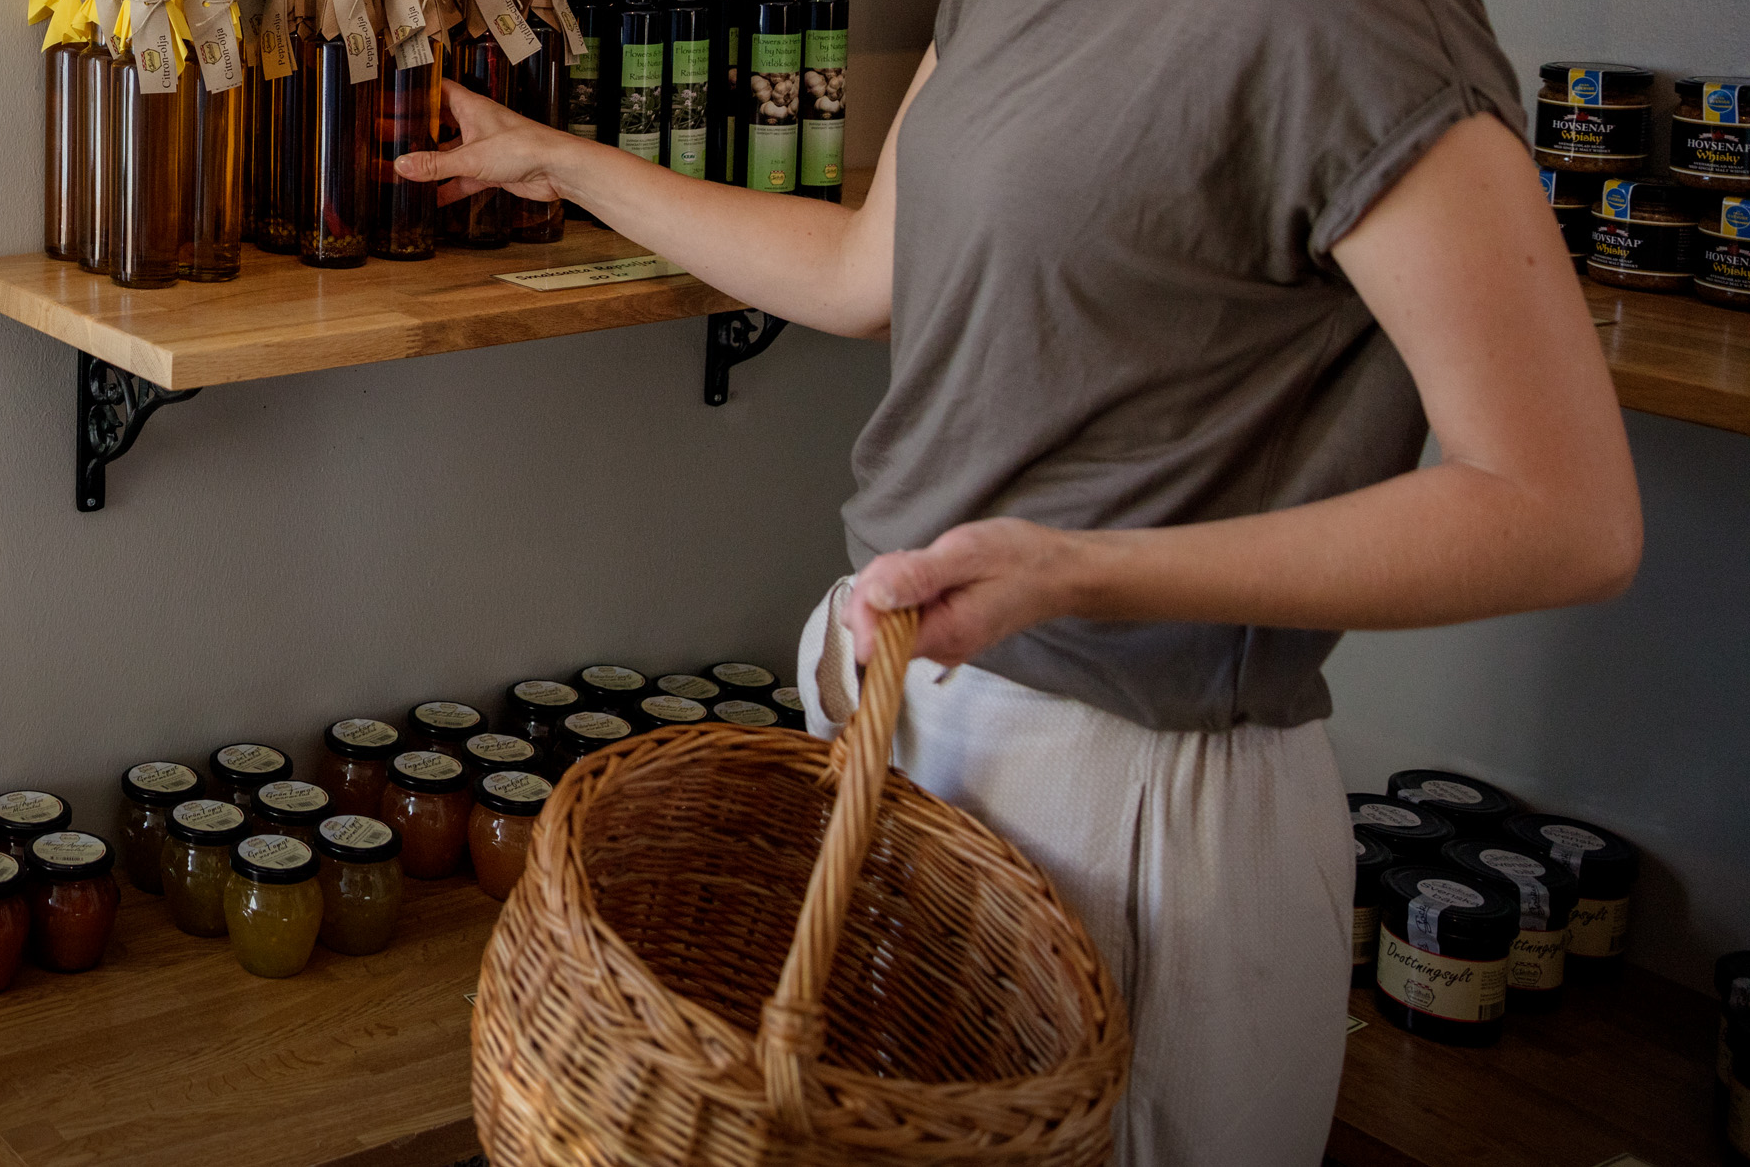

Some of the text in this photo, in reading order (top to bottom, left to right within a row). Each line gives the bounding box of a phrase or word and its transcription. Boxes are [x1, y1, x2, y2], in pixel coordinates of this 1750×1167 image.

[273, 13, 286, 66] Peppar-olja
[357, 15, 375, 68] Peppar-olja
[819, 42, 829, 52] by
[215, 27, 234, 80] Citron-olja
[764, 46, 774, 56] by
[157, 34, 171, 89] Citron-olja
[637, 59, 646, 70] by
[687, 55, 697, 66] by
[1552, 119, 1614, 133] HOVSENAP
[1561, 130, 1603, 145] Whisky
[1696, 149, 1740, 165] Whisky
[1591, 231, 1641, 248] HOVSENAP
[1595, 242, 1630, 258] Whisky
[515, 258, 658, 281] Smaksatta Rapsoljor
[1387, 941, 1474, 986] Drottningsylt
